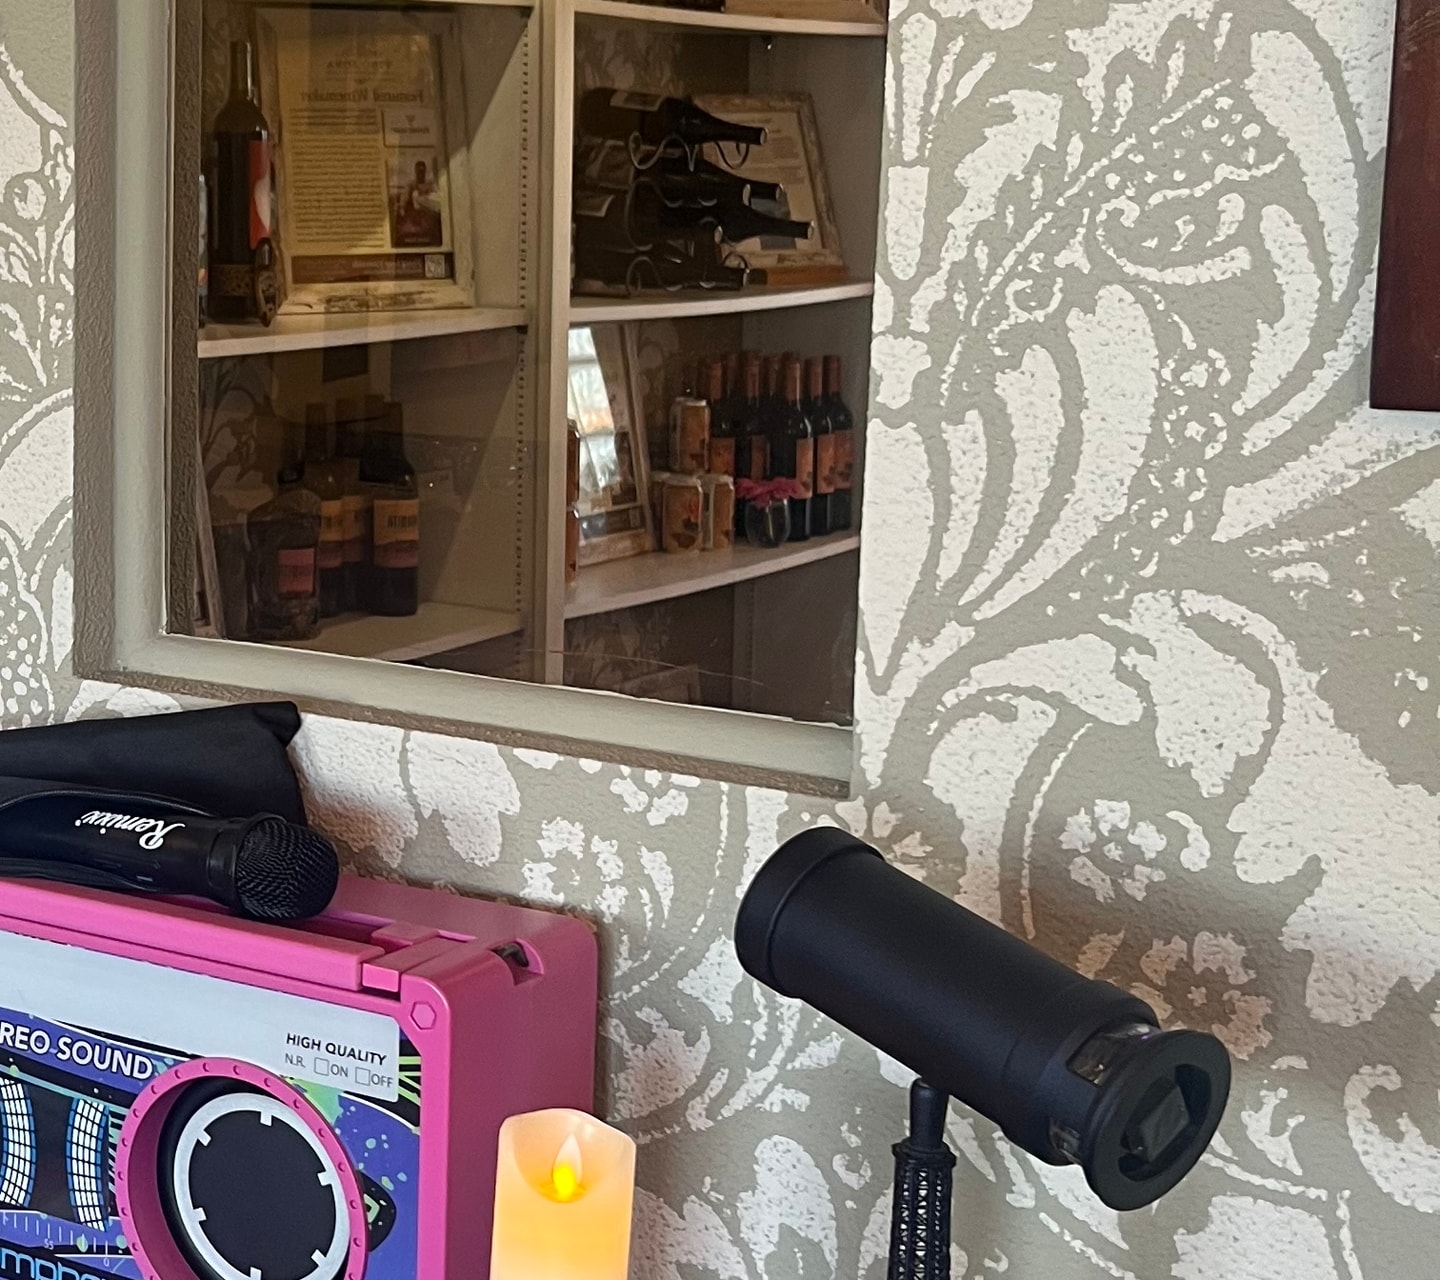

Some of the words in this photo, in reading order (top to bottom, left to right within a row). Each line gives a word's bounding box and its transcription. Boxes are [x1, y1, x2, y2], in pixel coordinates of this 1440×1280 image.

[56, 1036, 153, 1080] SOUND
[286, 1032, 321, 1051] HIGH
[325, 1042, 387, 1065] QUALITY
[330, 1064, 348, 1077] ON
[371, 1074, 393, 1088] OFF
[44, 1238, 54, 1249] 55
